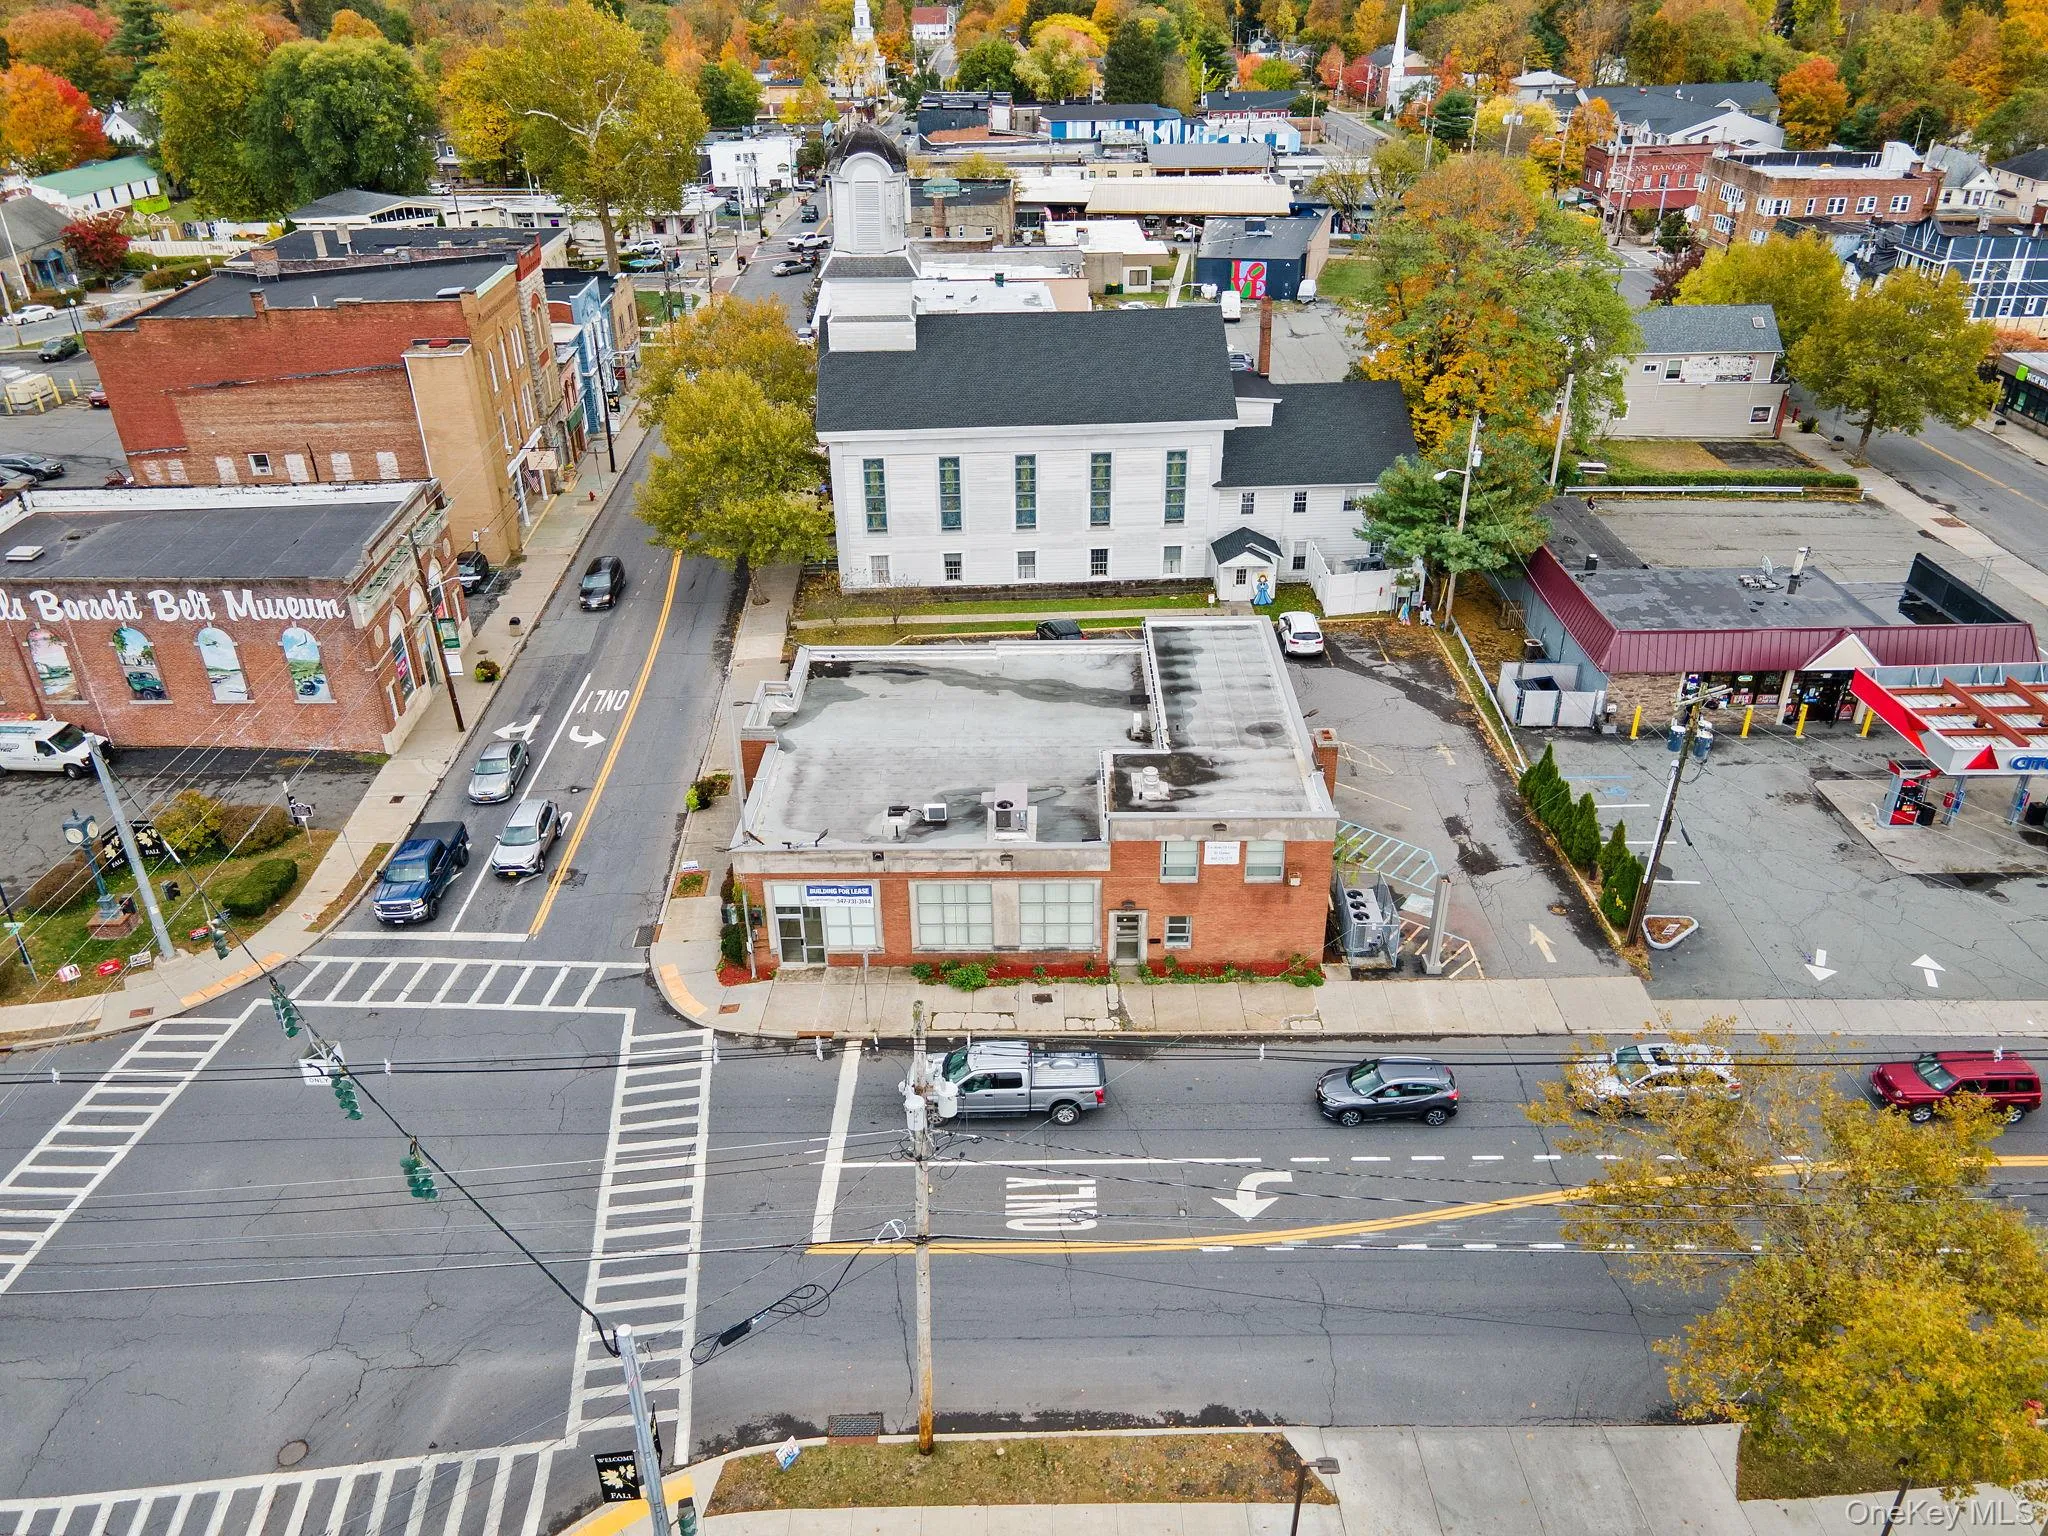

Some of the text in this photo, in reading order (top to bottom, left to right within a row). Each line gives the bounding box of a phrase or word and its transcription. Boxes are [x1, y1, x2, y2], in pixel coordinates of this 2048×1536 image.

[1652, 163, 1690, 172] BAKERY
[29, 589, 143, 622] Borscht
[148, 589, 216, 622] Belt
[222, 589, 346, 622] Museum
[577, 690, 629, 713] ONLY
[145, 848, 161, 856] FALL
[111, 857, 125, 868] FALL
[809, 887, 870, 895] BUILDING FOR LEASE
[1004, 1177, 1098, 1232] ONLY
[596, 1455, 634, 1463] WELCOME
